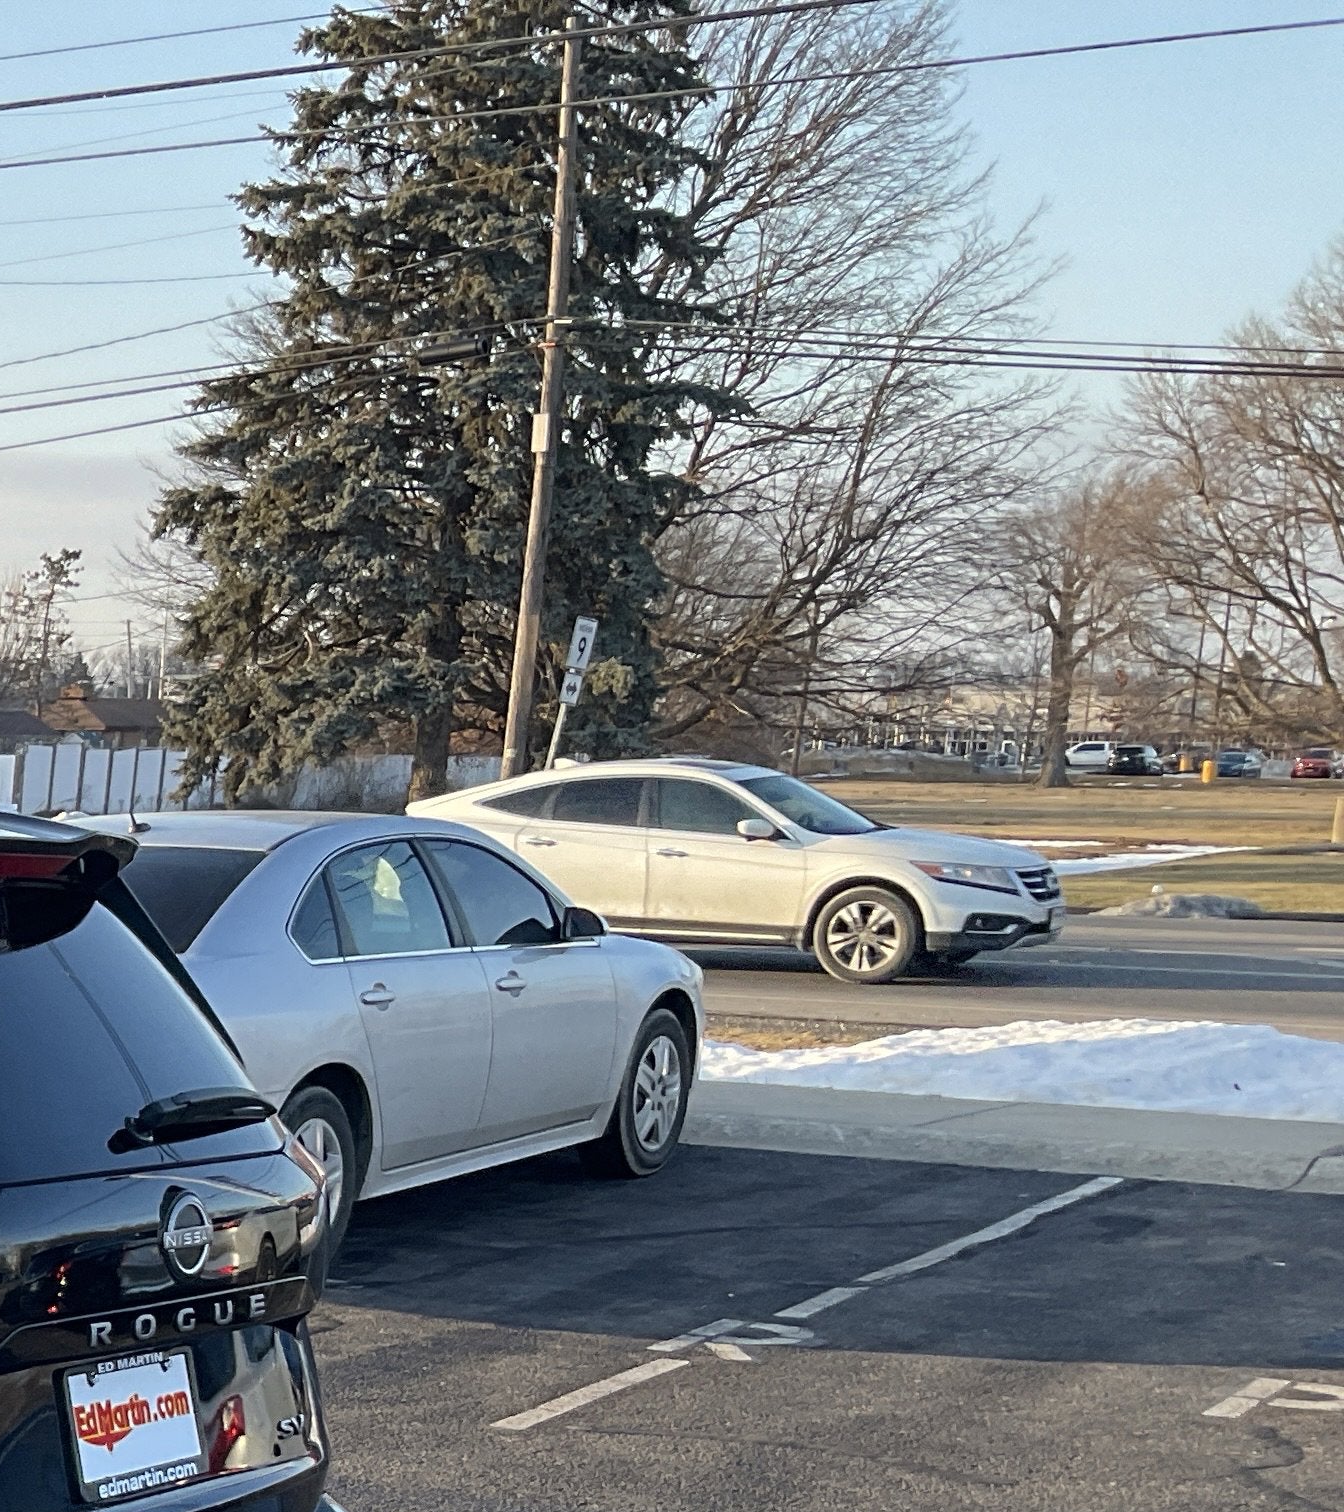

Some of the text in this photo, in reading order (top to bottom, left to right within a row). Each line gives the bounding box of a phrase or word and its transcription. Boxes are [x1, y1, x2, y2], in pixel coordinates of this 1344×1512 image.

[164, 1229, 209, 1249] NISSA
[90, 1294, 266, 1348] ROGUE
[97, 1351, 163, 1374] ED MARTIN
[74, 1392, 190, 1438] EdMartin.com
[277, 1413, 305, 1440] SV
[99, 1462, 198, 1499] edmartin.com
